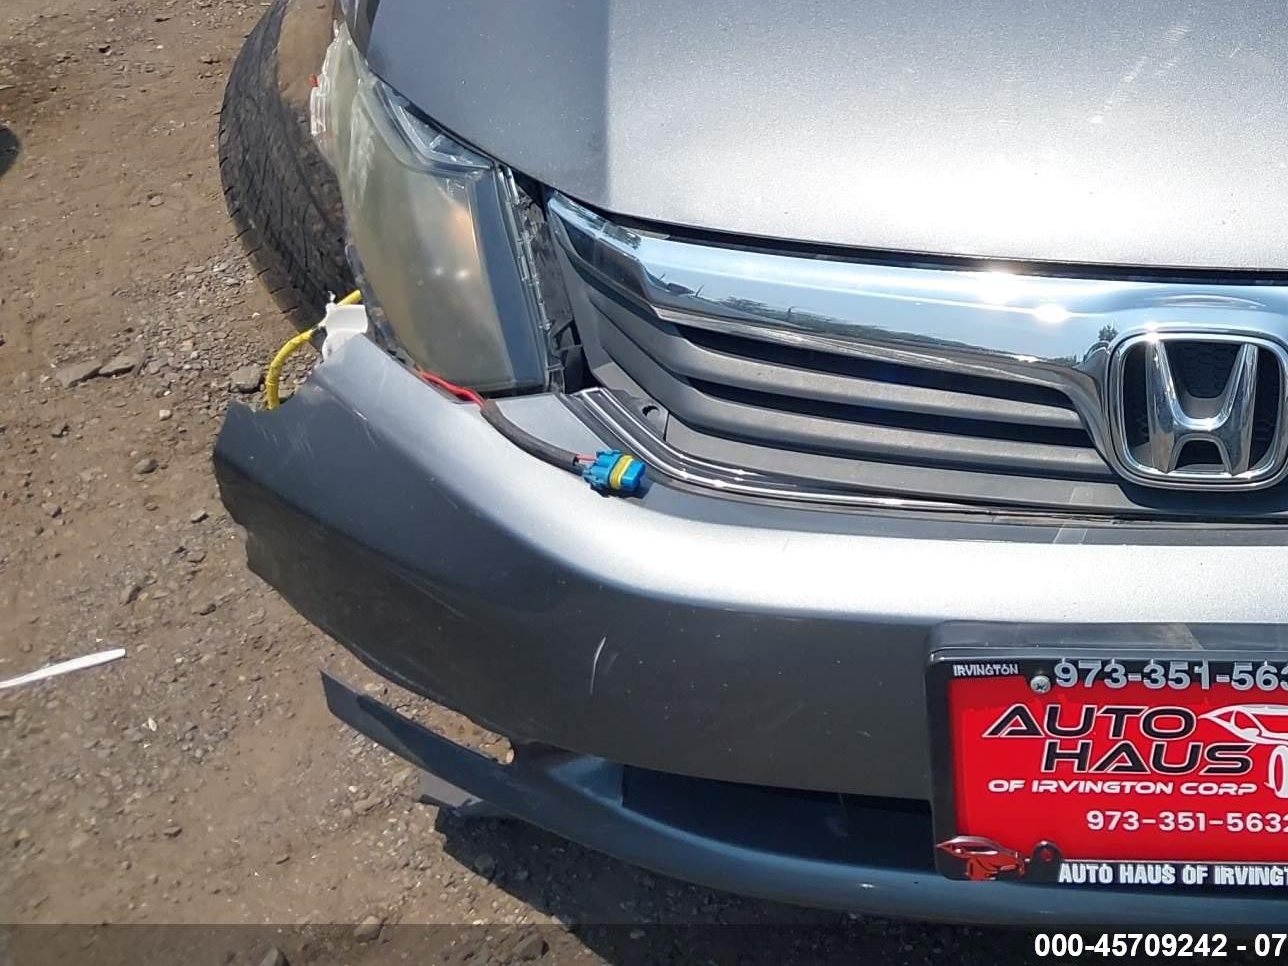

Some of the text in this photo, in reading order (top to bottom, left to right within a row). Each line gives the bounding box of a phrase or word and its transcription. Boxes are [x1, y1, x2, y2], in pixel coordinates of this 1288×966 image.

[953, 664, 1018, 676] IRVINGTON
[982, 703, 1197, 740] AUTO
[1041, 739, 1257, 776] HAUS
[988, 780, 1258, 795] OF IRVINGTON CORP
[1059, 863, 1113, 884] AUTO
[1119, 864, 1176, 884] HAUS
[1182, 864, 1208, 884] OF
